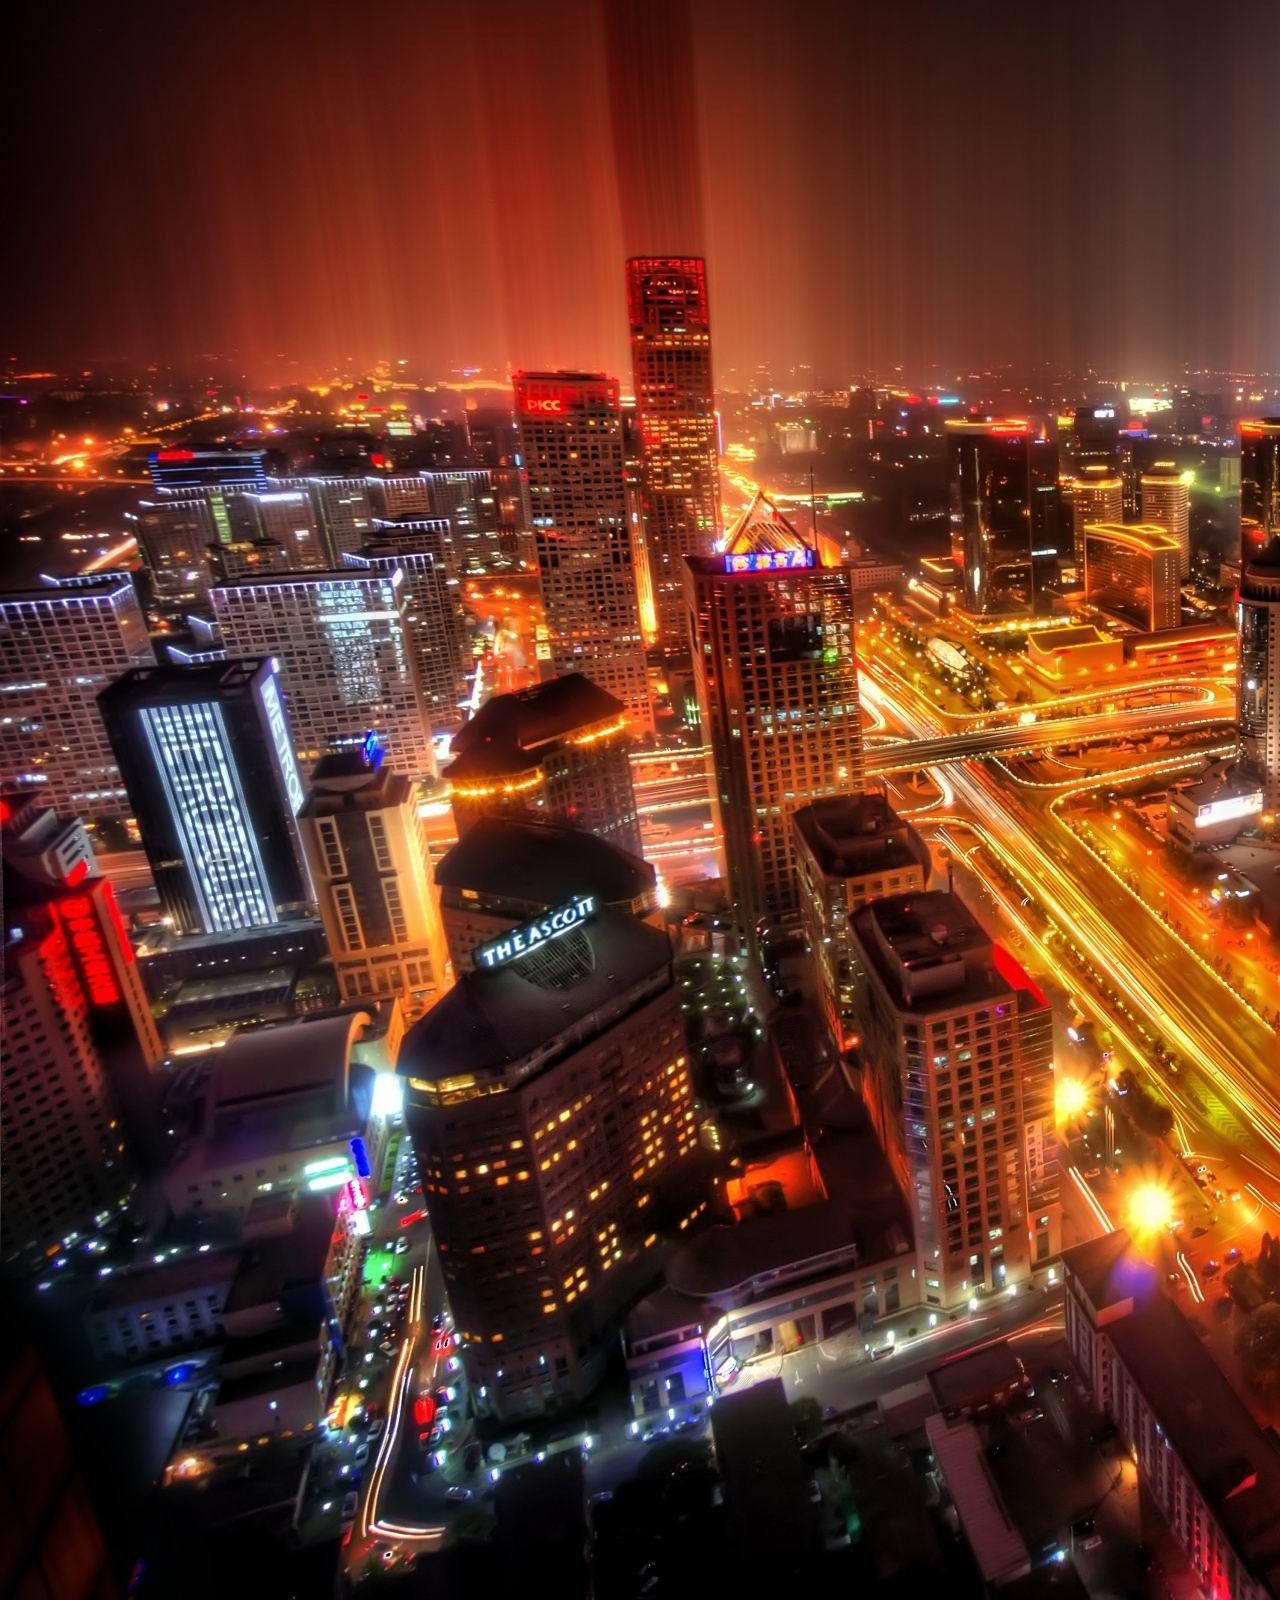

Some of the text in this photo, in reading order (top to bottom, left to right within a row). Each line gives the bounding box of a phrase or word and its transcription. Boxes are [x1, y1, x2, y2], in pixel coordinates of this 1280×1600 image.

[527, 400, 561, 411] PICC
[154, 711, 271, 924] METROPOLIS
[483, 896, 595, 966] THE ASCOTT
